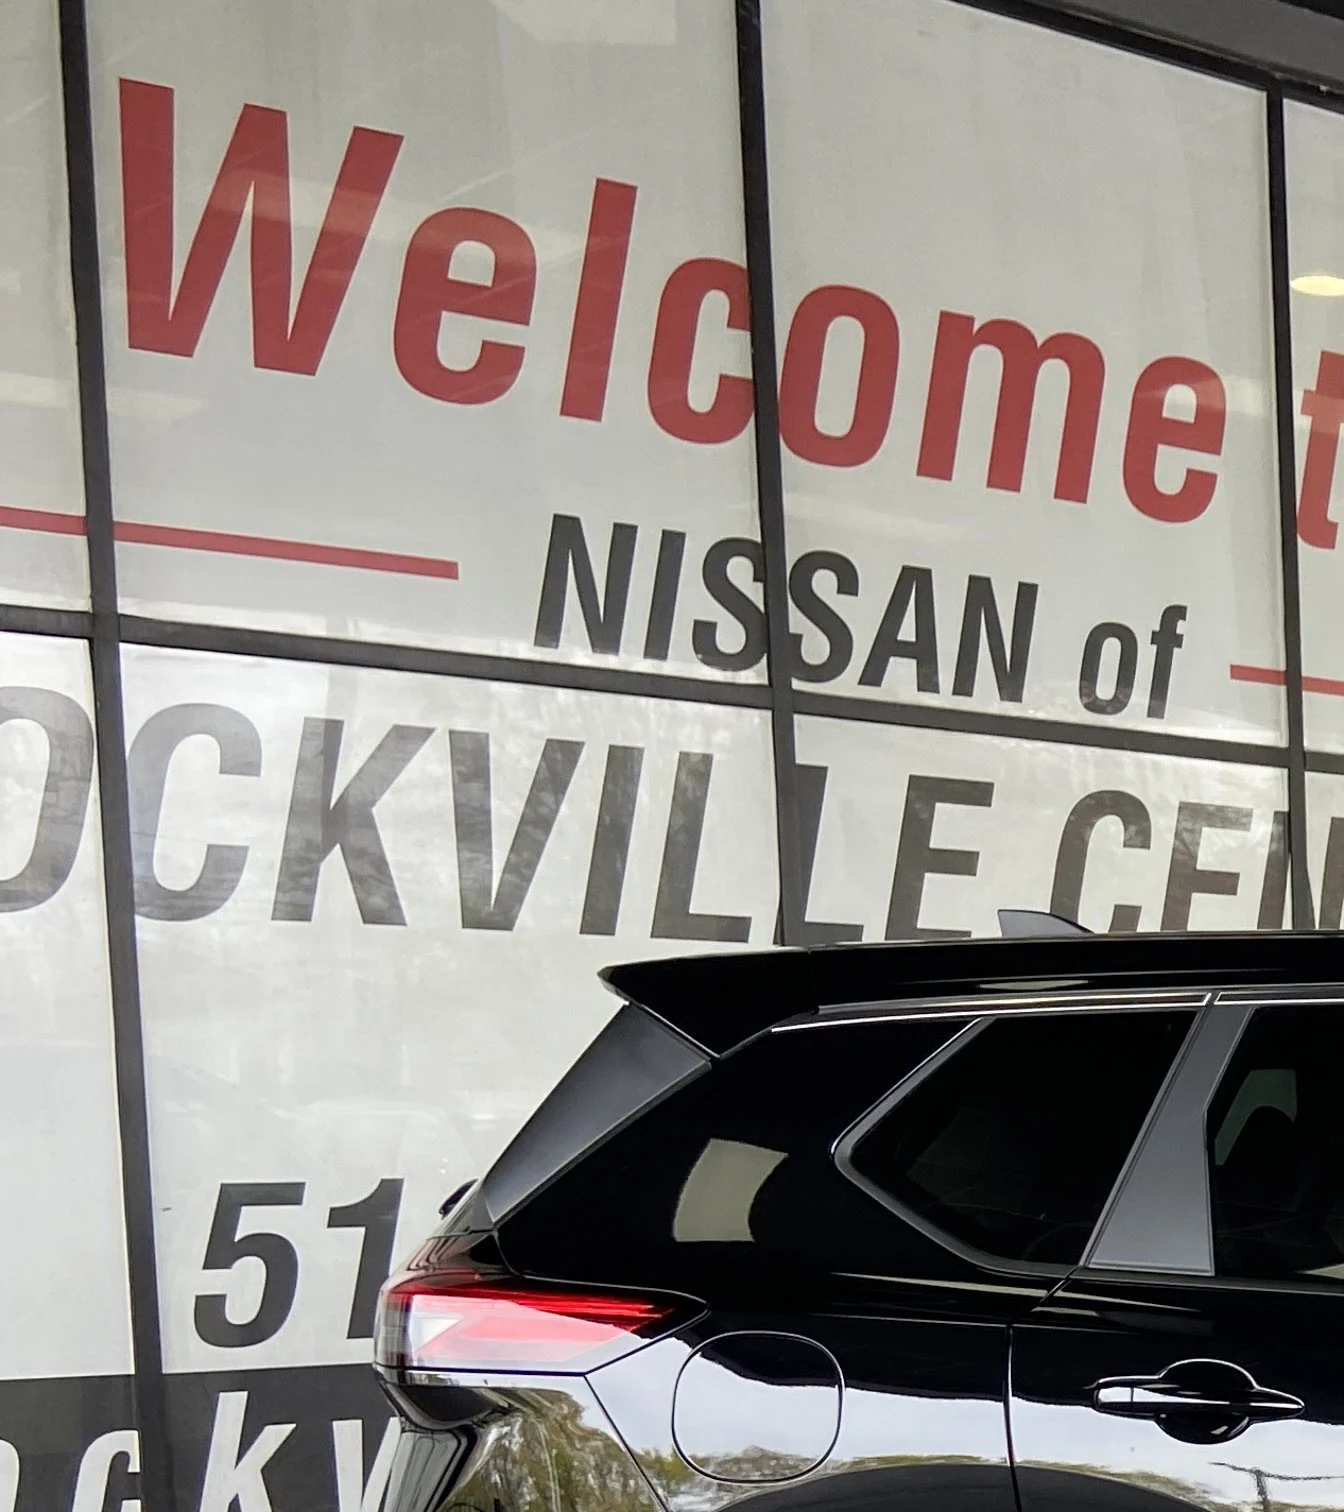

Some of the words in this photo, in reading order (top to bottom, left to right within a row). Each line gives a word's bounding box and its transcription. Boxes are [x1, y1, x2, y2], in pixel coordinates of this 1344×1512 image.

[118, 77, 1227, 524] Welcome
[533, 513, 1039, 704] NISSAN
[1078, 603, 1188, 721] of
[193, 1178, 405, 1349] 51
